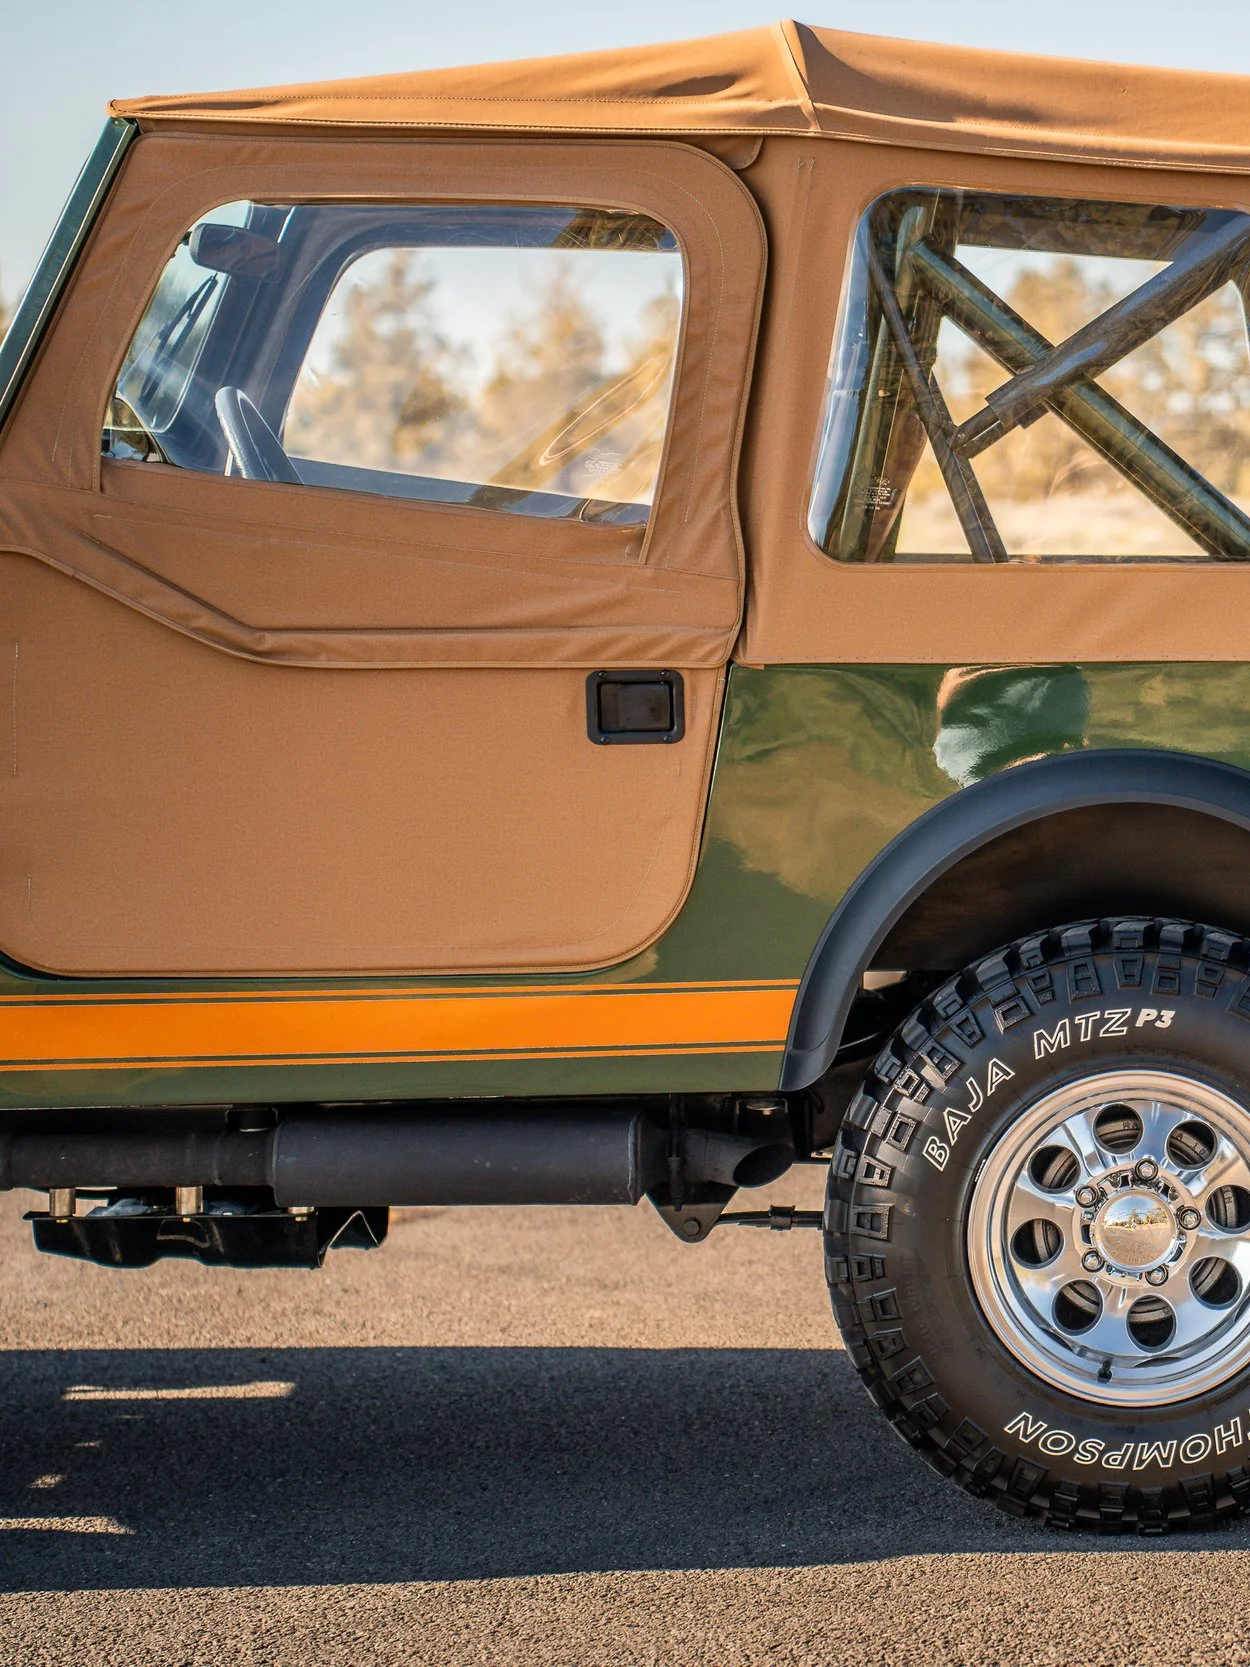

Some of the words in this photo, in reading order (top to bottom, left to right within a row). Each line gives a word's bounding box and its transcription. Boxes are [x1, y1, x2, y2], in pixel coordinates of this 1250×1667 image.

[921, 1057, 1015, 1171] BAJA
[1033, 1007, 1132, 1060] MTZ
[1134, 1008, 1176, 1029] P3
